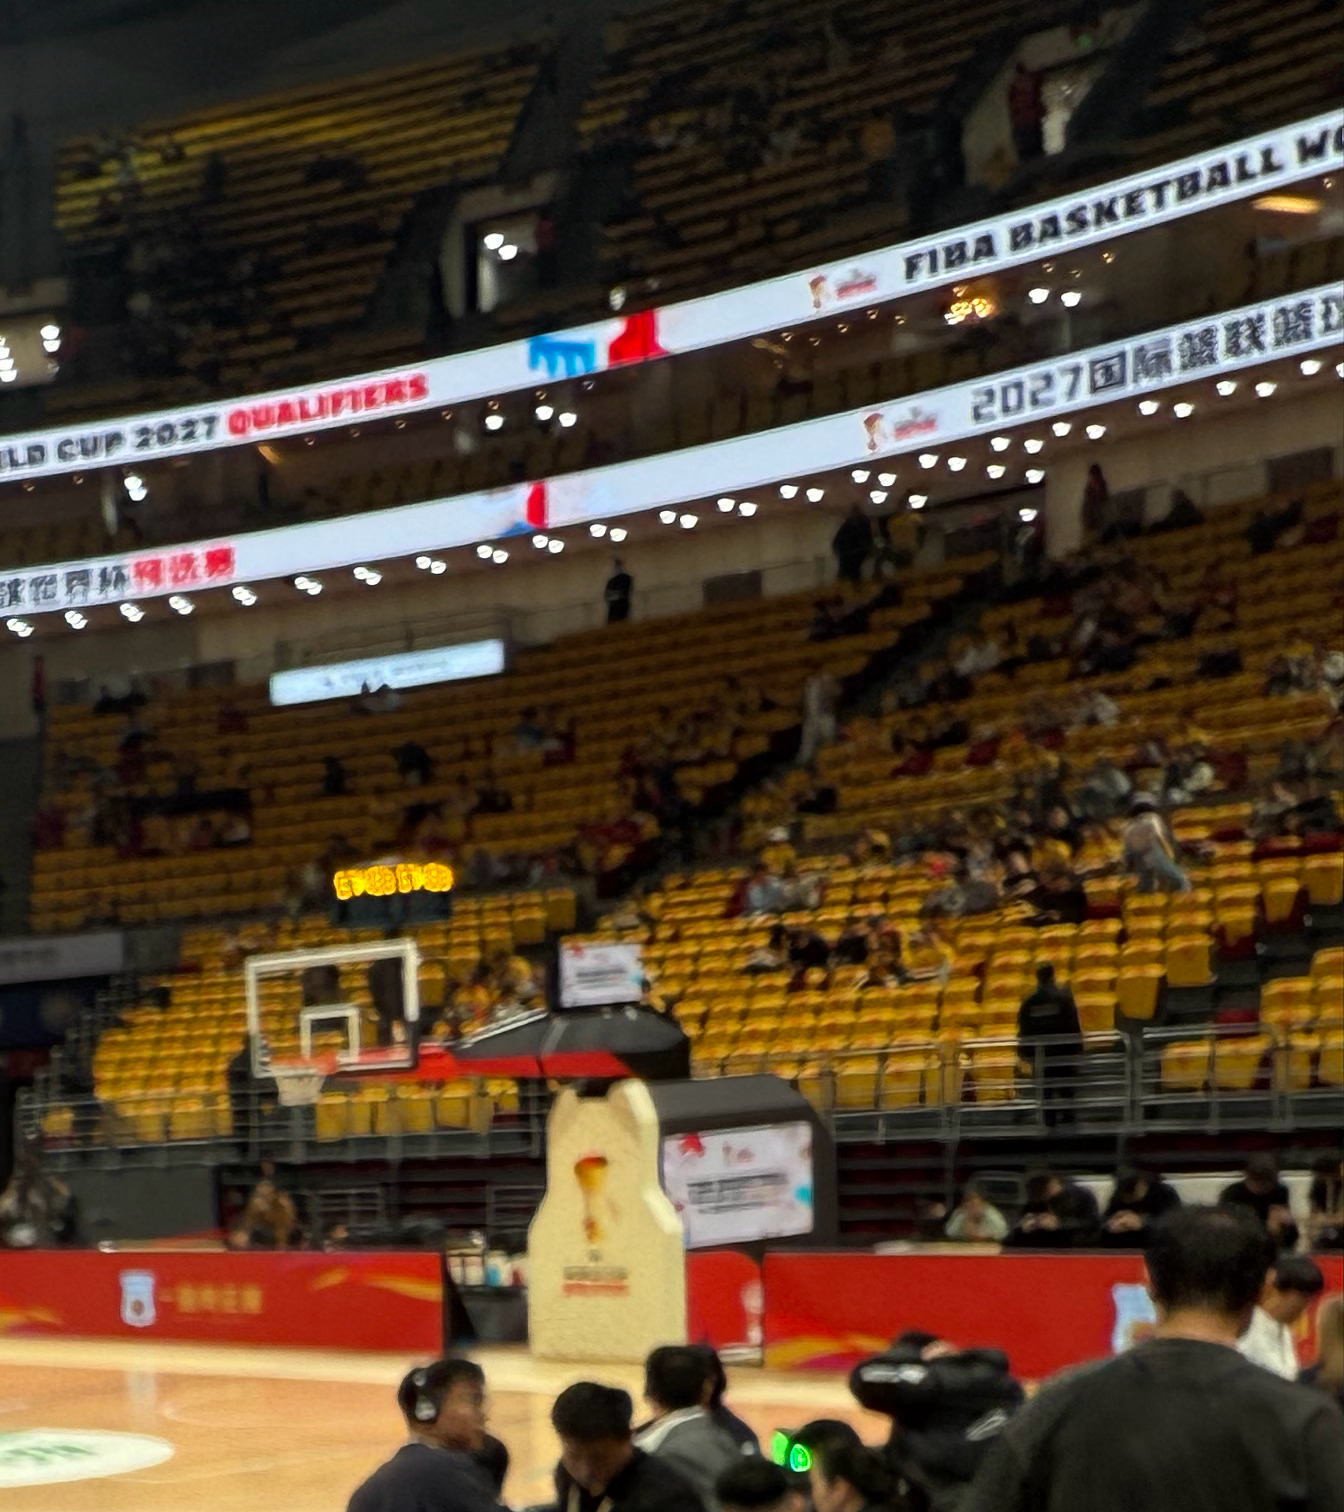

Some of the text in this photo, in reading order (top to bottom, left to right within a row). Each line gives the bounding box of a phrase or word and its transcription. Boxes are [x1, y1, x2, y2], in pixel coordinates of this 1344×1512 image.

[904, 233, 998, 283] FIBA
[1010, 146, 1283, 248] BASKETBALL
[56, 430, 125, 462] CUP
[134, 414, 220, 451] 2027
[227, 372, 429, 437] QUALIFIERS
